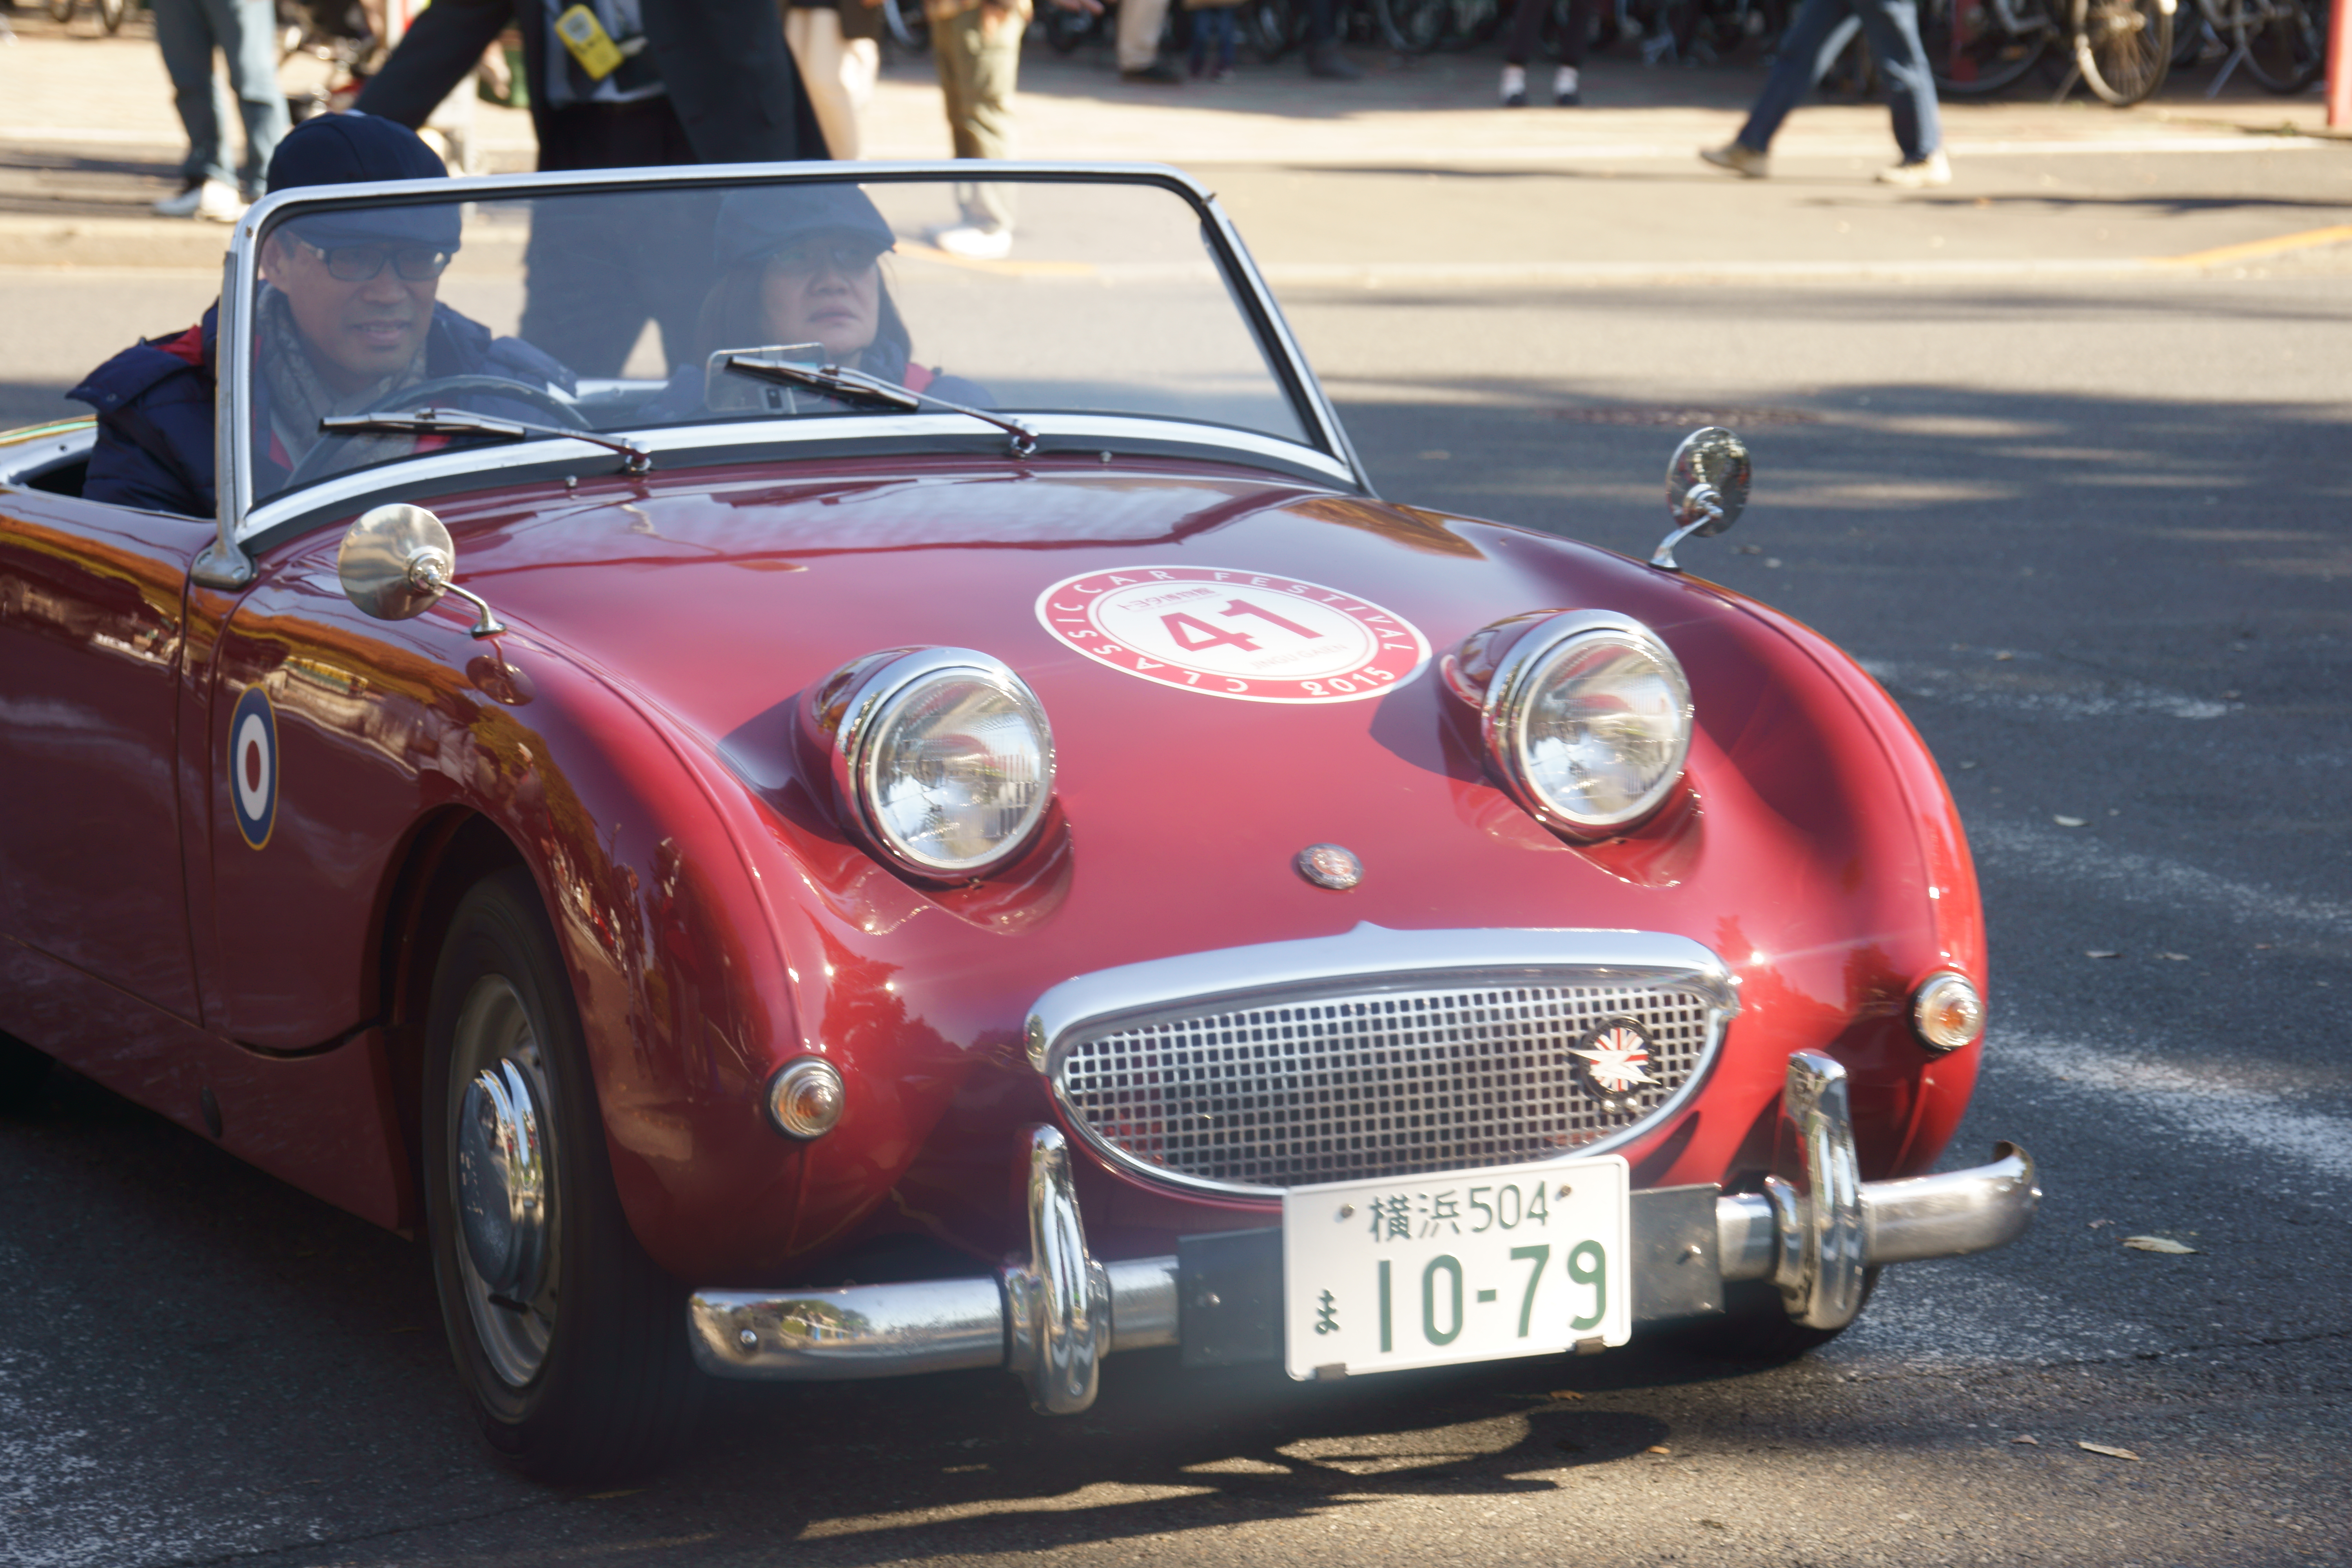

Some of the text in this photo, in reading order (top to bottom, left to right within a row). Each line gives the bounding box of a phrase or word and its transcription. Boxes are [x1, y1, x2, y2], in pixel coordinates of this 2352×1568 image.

[1054, 571, 1414, 692] CLASSIC CAR FESTIVAL
[1160, 599, 1325, 652] 41
[1249, 643, 1349, 670] JINGU GAIEN
[1301, 666, 1395, 695] 2015
[1315, 1239, 1607, 1353] ま 10-79
